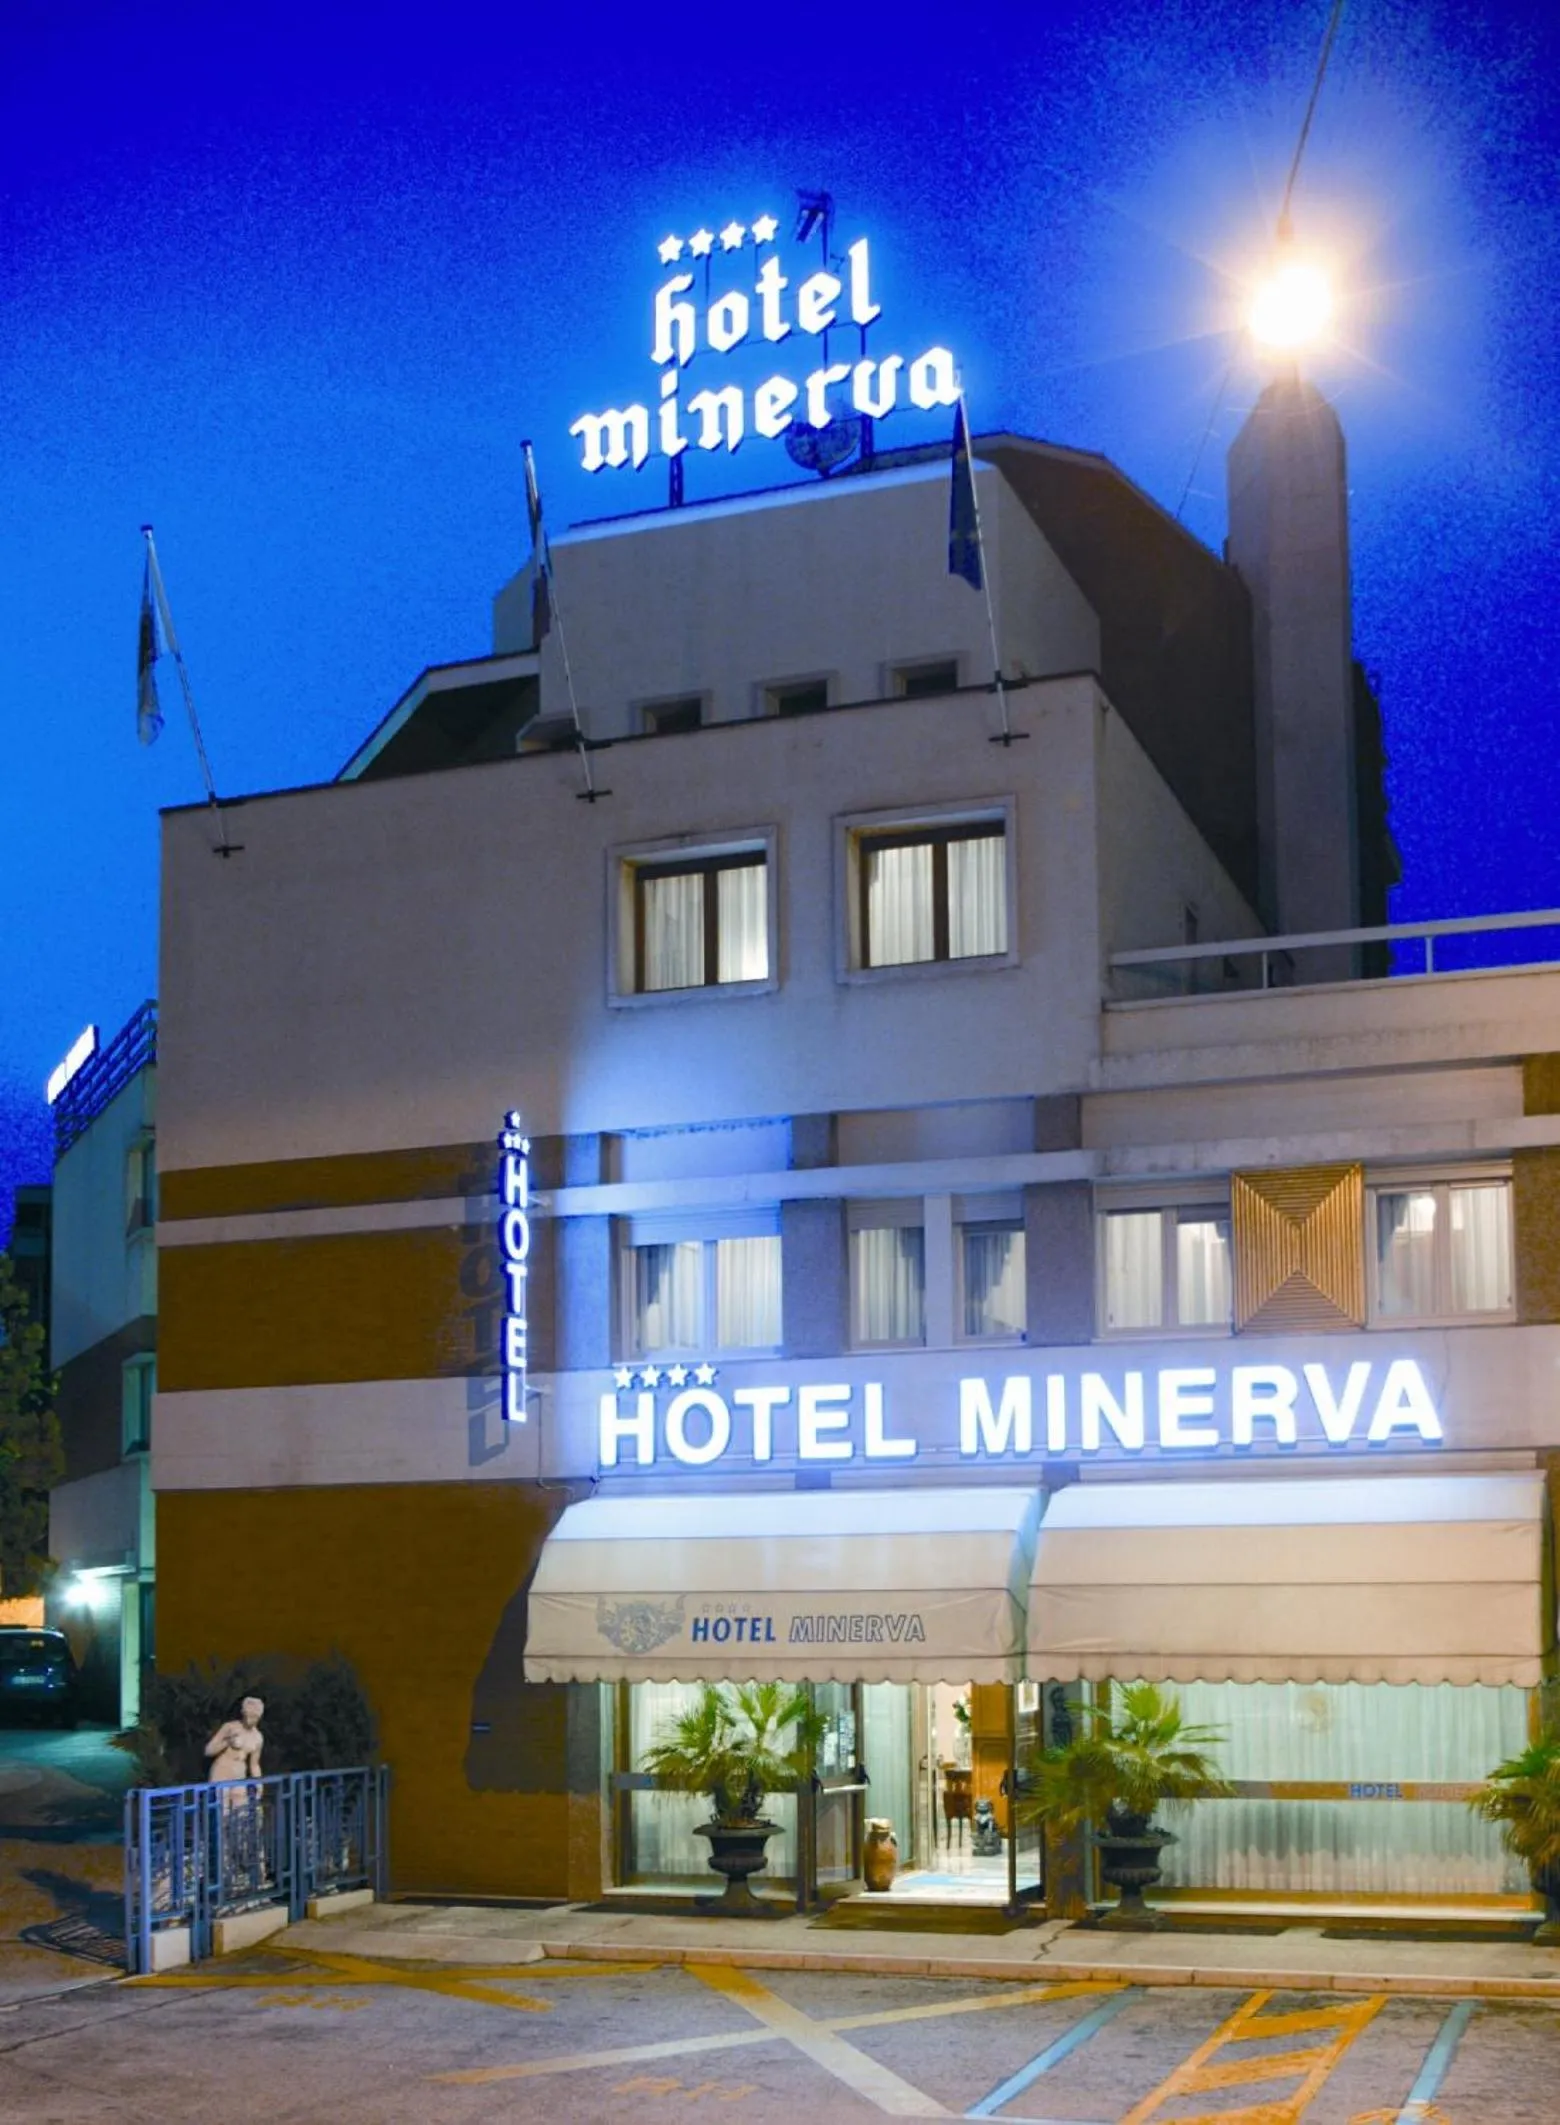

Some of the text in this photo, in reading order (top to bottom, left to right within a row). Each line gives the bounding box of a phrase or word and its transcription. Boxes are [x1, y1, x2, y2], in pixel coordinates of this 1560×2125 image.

[650, 237, 881, 368] hotel
[569, 346, 963, 473] minerva
[500, 1155, 530, 1423] HOTEL
[599, 1358, 1445, 1466] HOTEL MINERVA
[691, 1614, 926, 1643] HOTEL MINERVA
[1350, 1781, 1403, 1799] HOTEL
